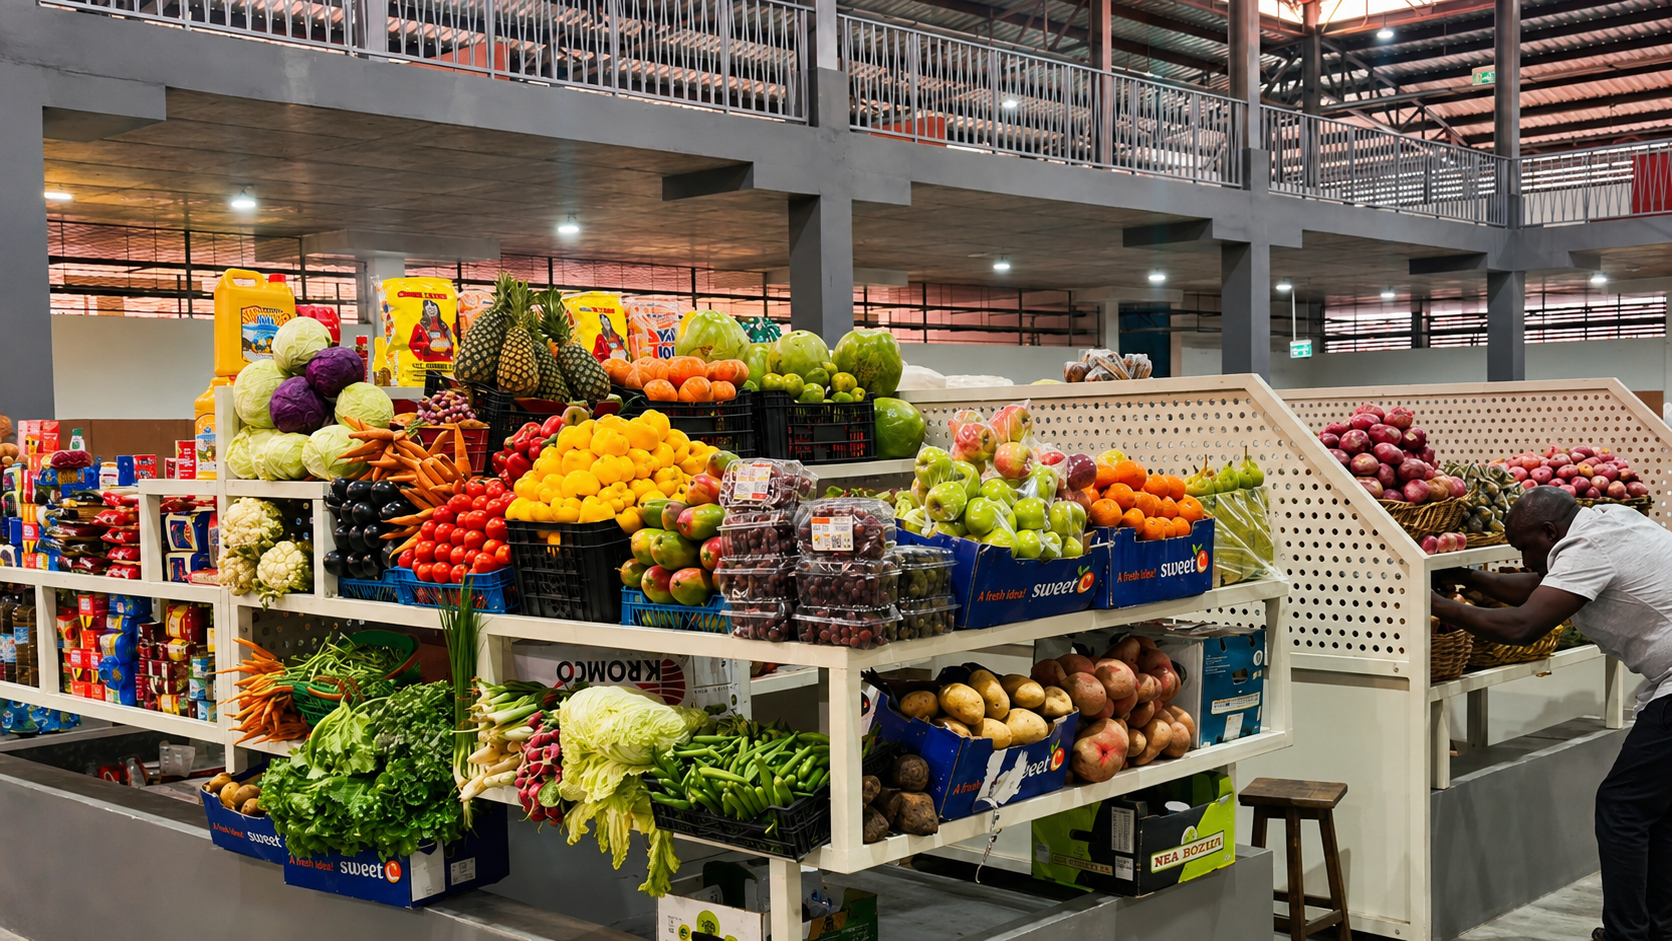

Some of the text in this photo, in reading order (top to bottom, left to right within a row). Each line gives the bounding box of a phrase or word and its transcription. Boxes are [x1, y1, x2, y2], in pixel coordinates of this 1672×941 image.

[977, 591, 984, 602] A
[986, 589, 1005, 602] fresh
[1006, 588, 1027, 600] idea!
[556, 660, 662, 683] KROMCO
[1154, 851, 1180, 868] NEA
